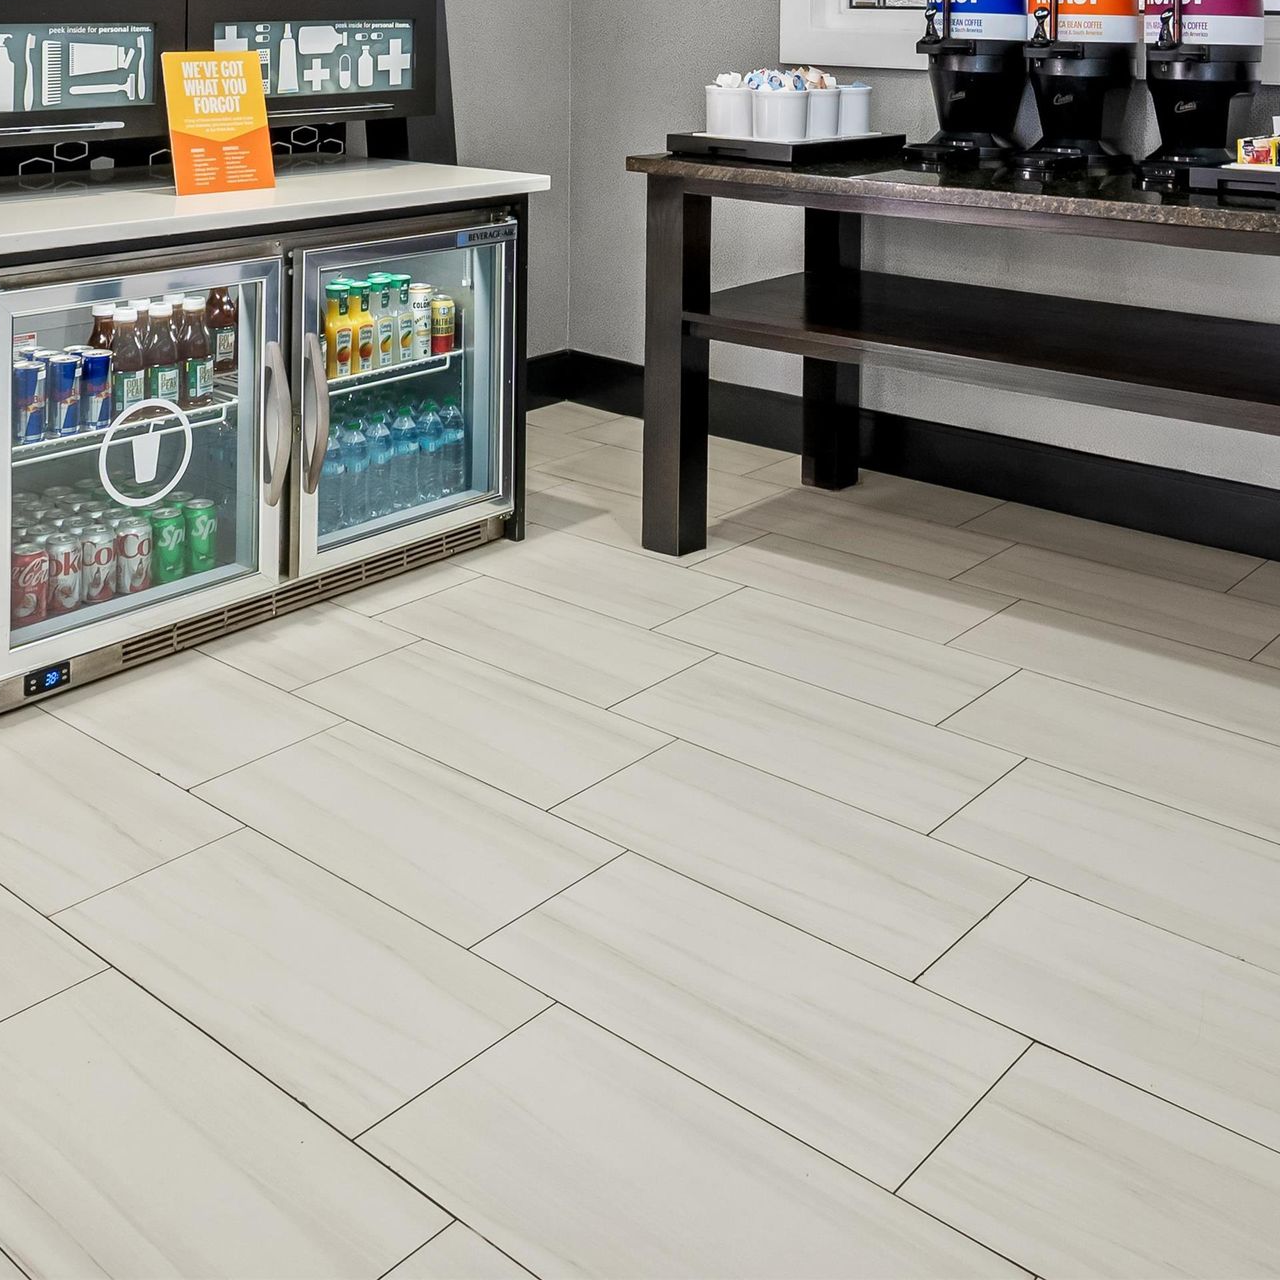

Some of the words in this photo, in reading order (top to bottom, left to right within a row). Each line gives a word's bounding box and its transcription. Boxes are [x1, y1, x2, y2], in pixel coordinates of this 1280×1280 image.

[49, 26, 65, 34] peek
[99, 26, 129, 34] personal
[1083, 21, 1103, 29] COFFEE
[1187, 22, 1208, 30] COFFEE
[182, 61, 219, 78] WE'VE
[220, 61, 244, 77] GOT
[183, 79, 218, 96] WHAT
[221, 78, 247, 95] YOU
[193, 96, 241, 114] FORGOT
[117, 534, 151, 558] Co
